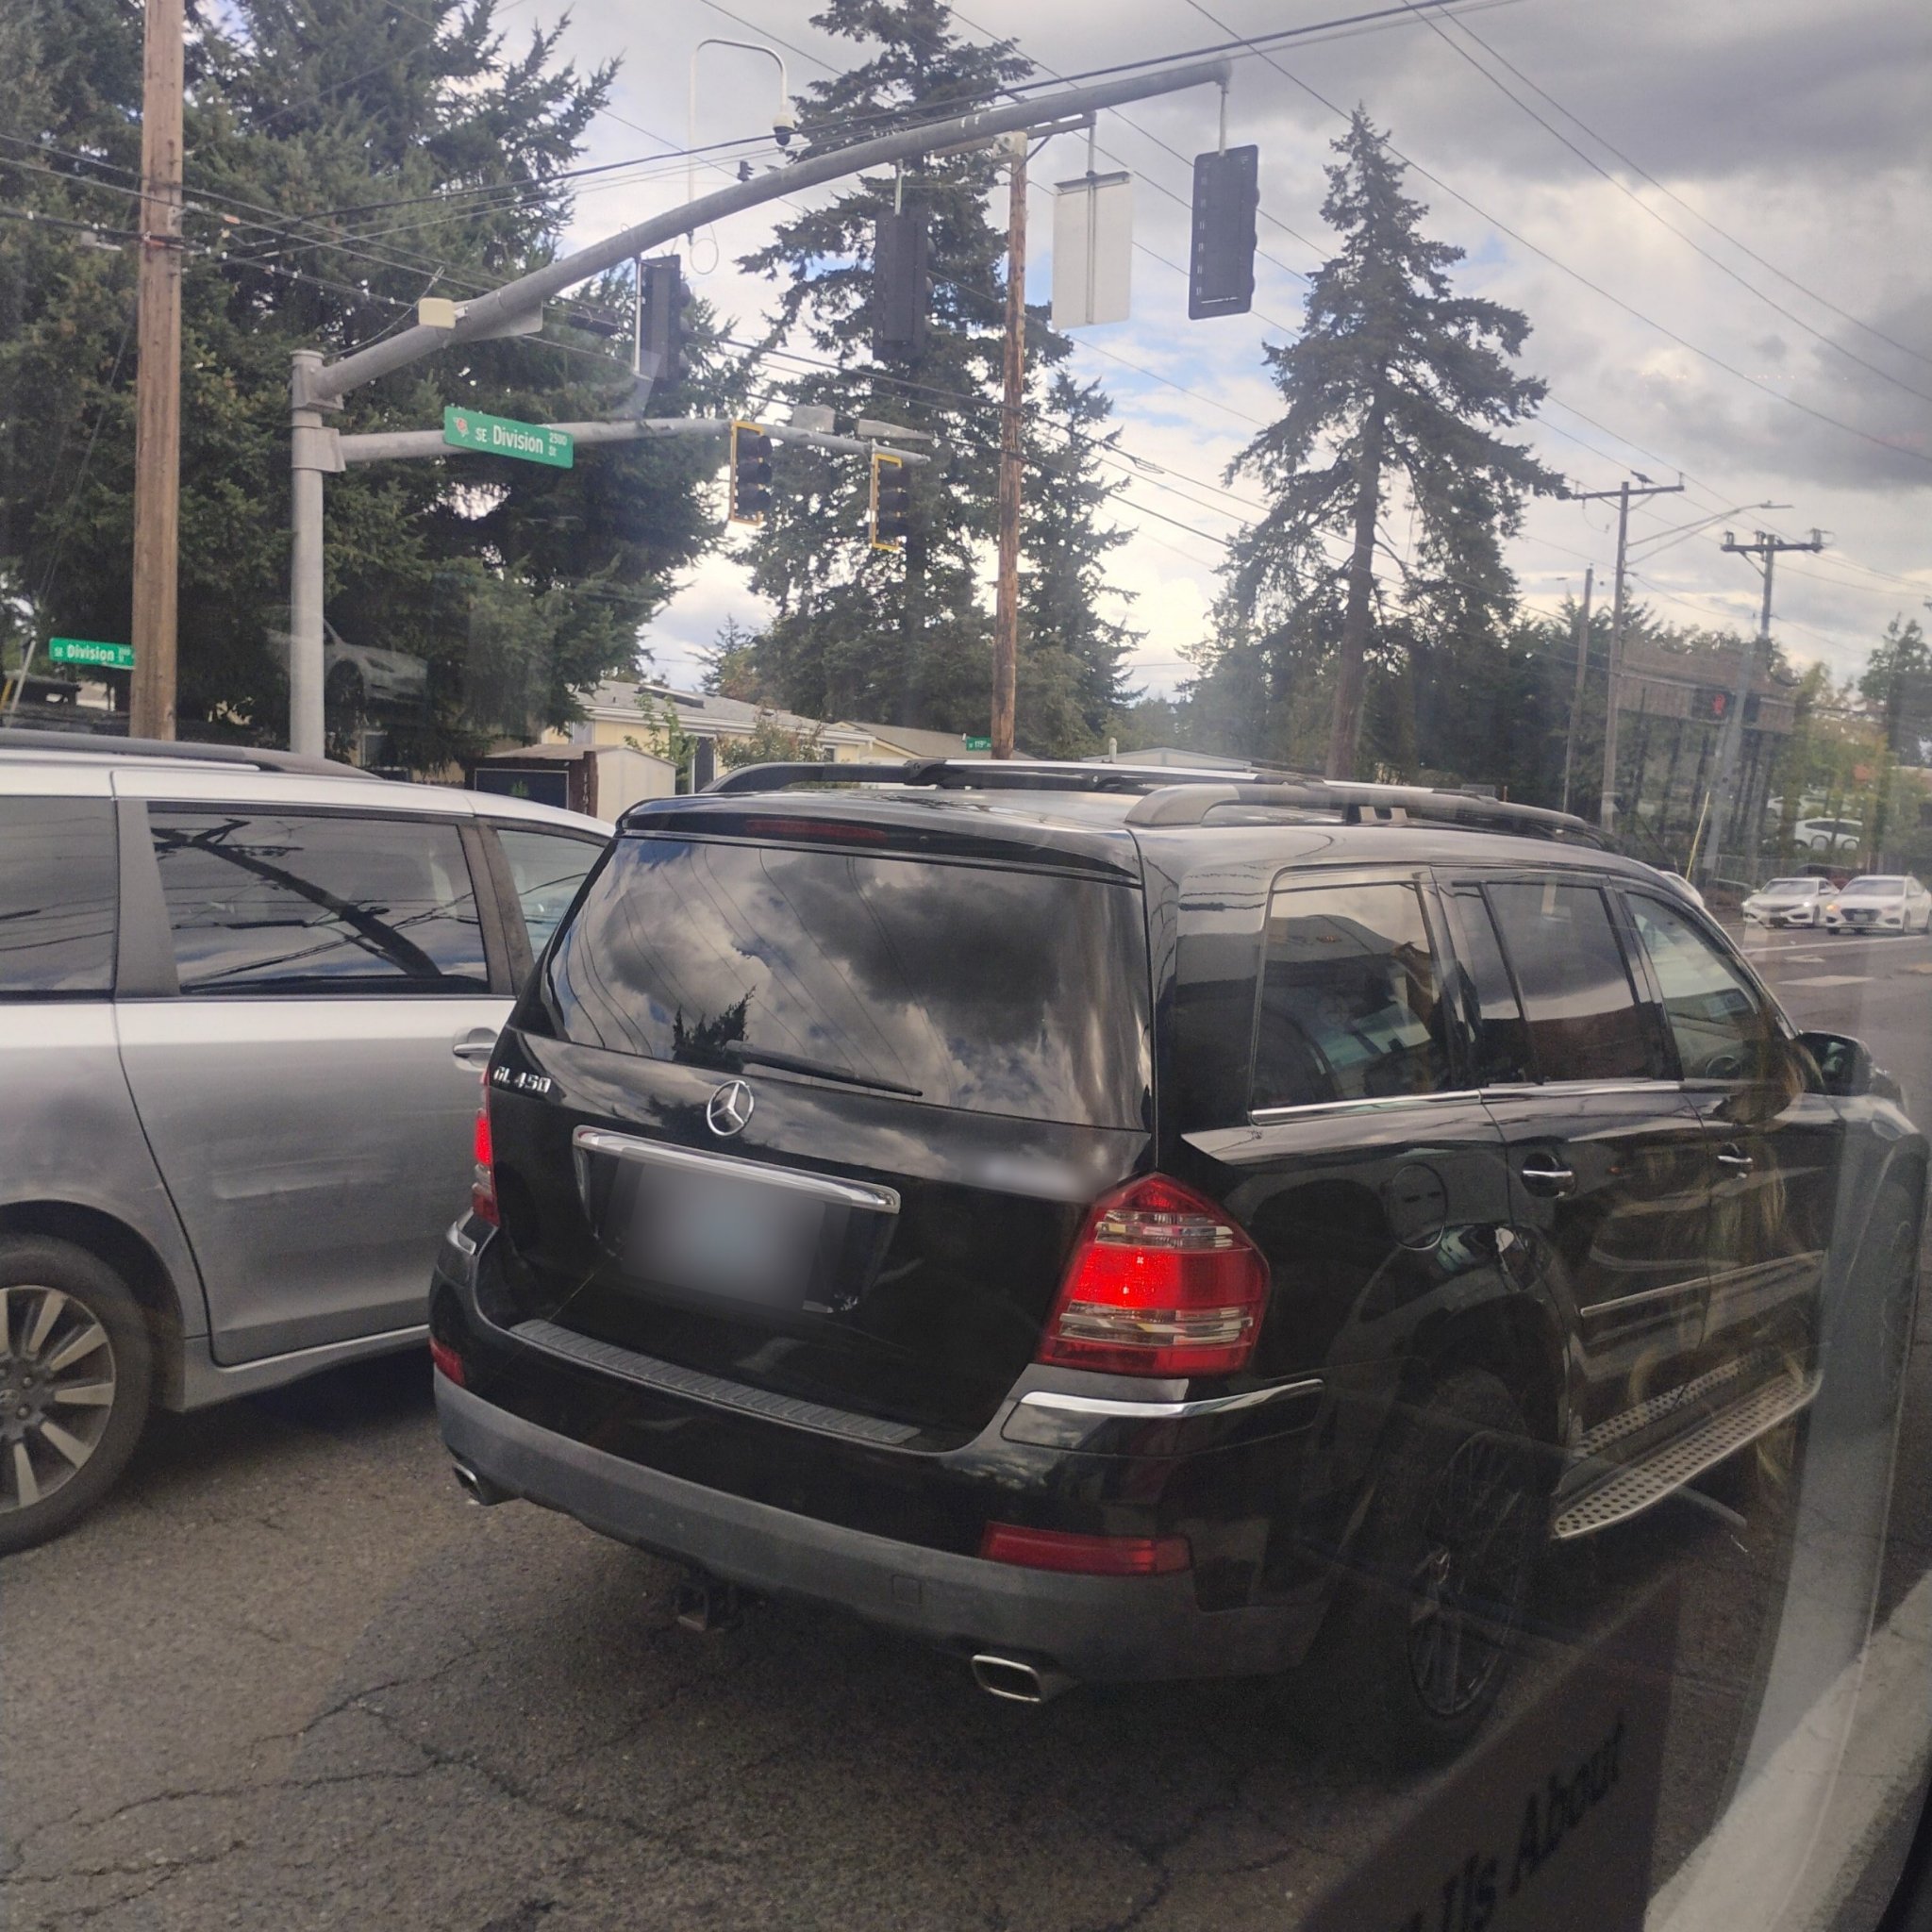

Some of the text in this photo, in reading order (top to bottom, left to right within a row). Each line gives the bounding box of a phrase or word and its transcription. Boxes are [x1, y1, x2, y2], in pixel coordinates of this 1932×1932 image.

[475, 427, 488, 442] SE
[492, 425, 543, 455] Division
[66, 643, 114, 661] Division
[492, 1066, 552, 1093] GL 450
